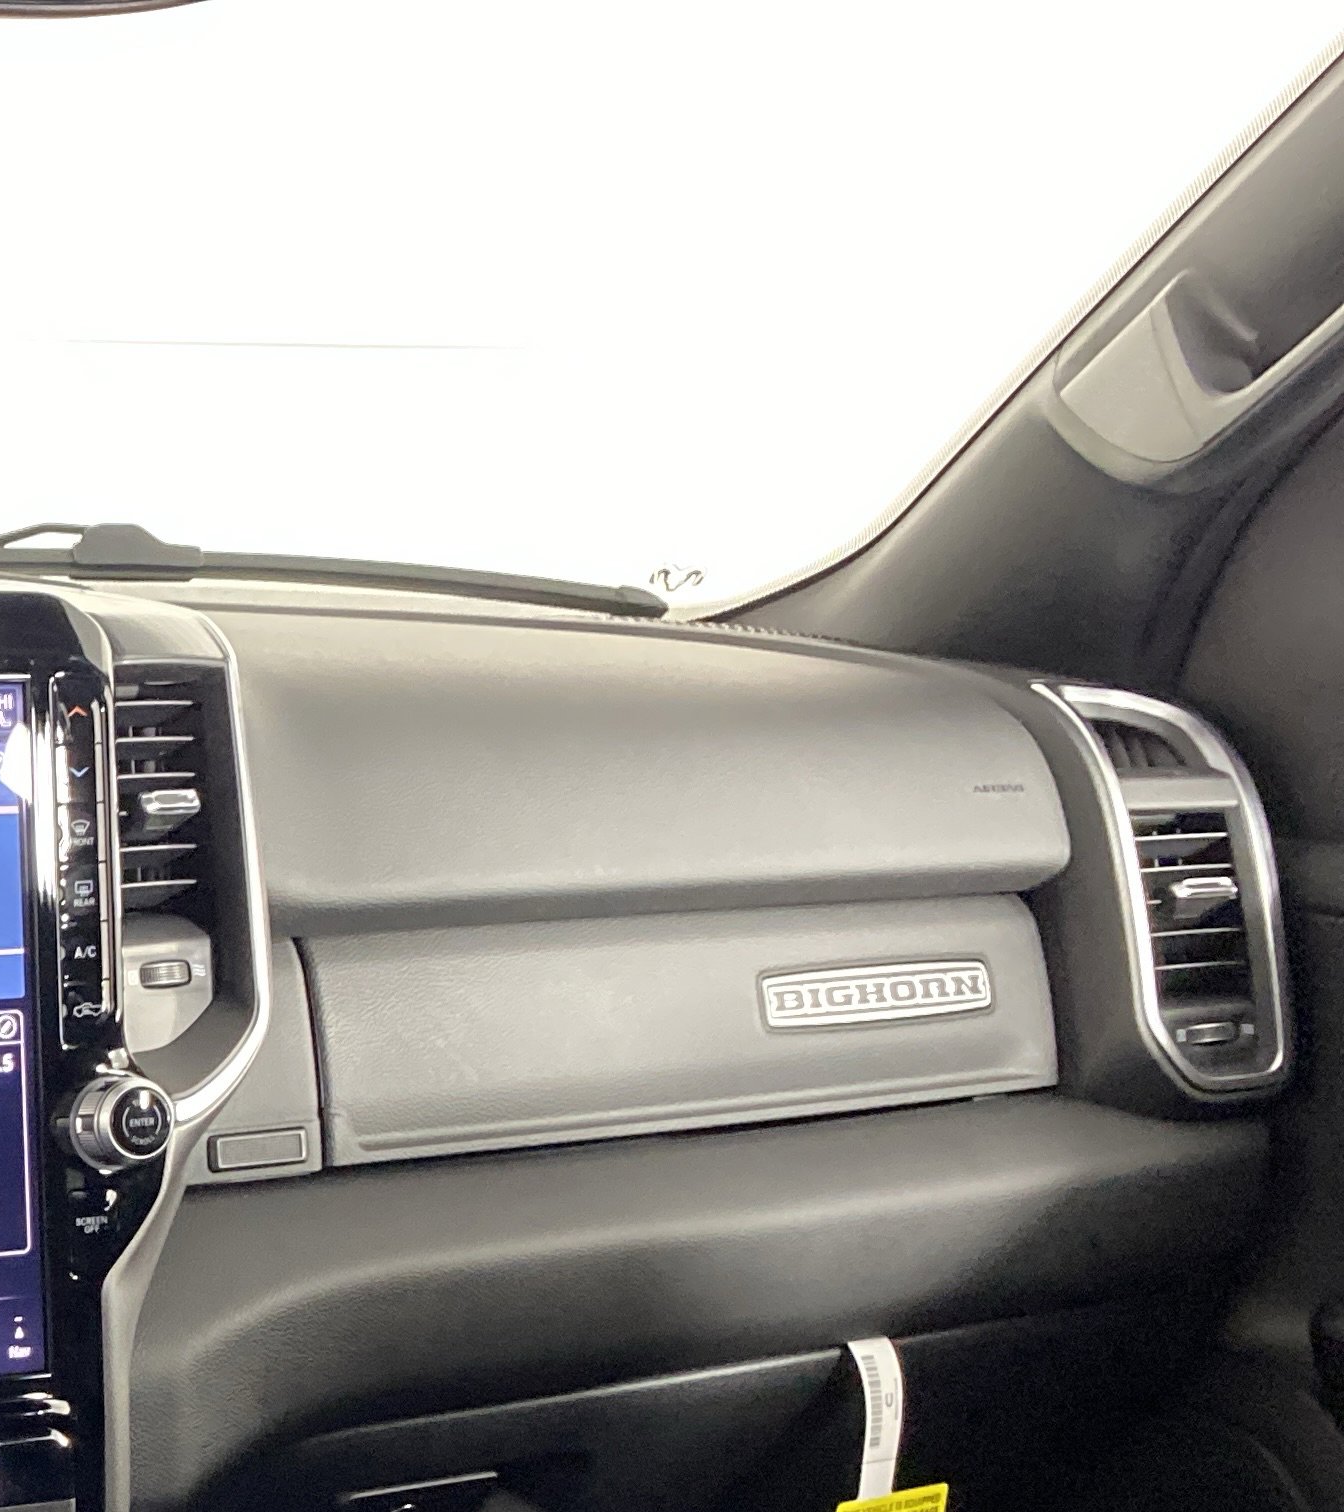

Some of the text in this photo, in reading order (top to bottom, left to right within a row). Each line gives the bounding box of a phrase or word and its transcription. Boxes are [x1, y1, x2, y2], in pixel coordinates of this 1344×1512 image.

[73, 945, 97, 959] A/C
[773, 974, 983, 1012] BIGHORN
[129, 1117, 155, 1127] ENTER
[75, 1216, 108, 1227] SCREEN
